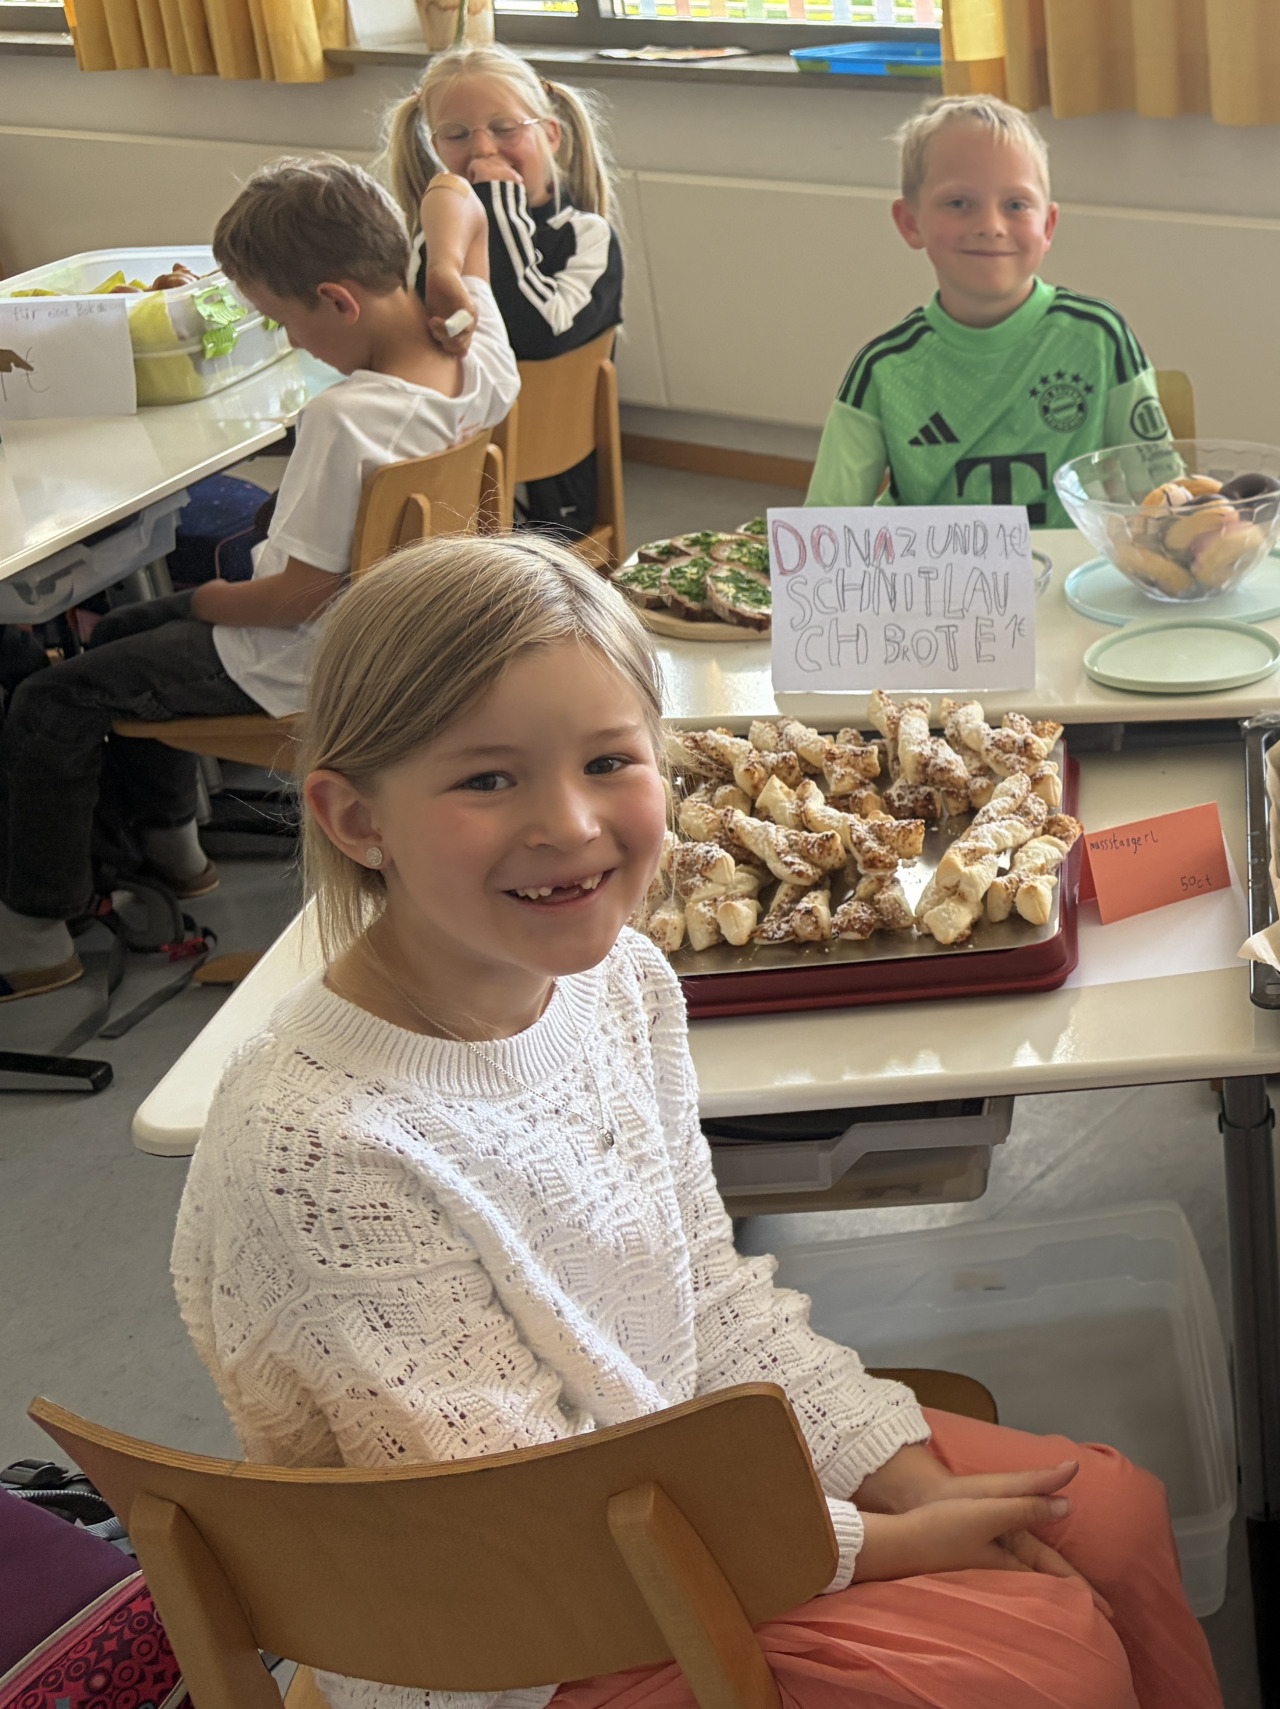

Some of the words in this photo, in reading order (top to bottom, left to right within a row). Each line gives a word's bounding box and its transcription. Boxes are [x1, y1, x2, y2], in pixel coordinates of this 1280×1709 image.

[772, 519, 917, 576] DONAZ
[926, 520, 988, 560] UND
[786, 563, 1010, 632] SCHNITLAU
[1004, 614, 1026, 649] 1€
